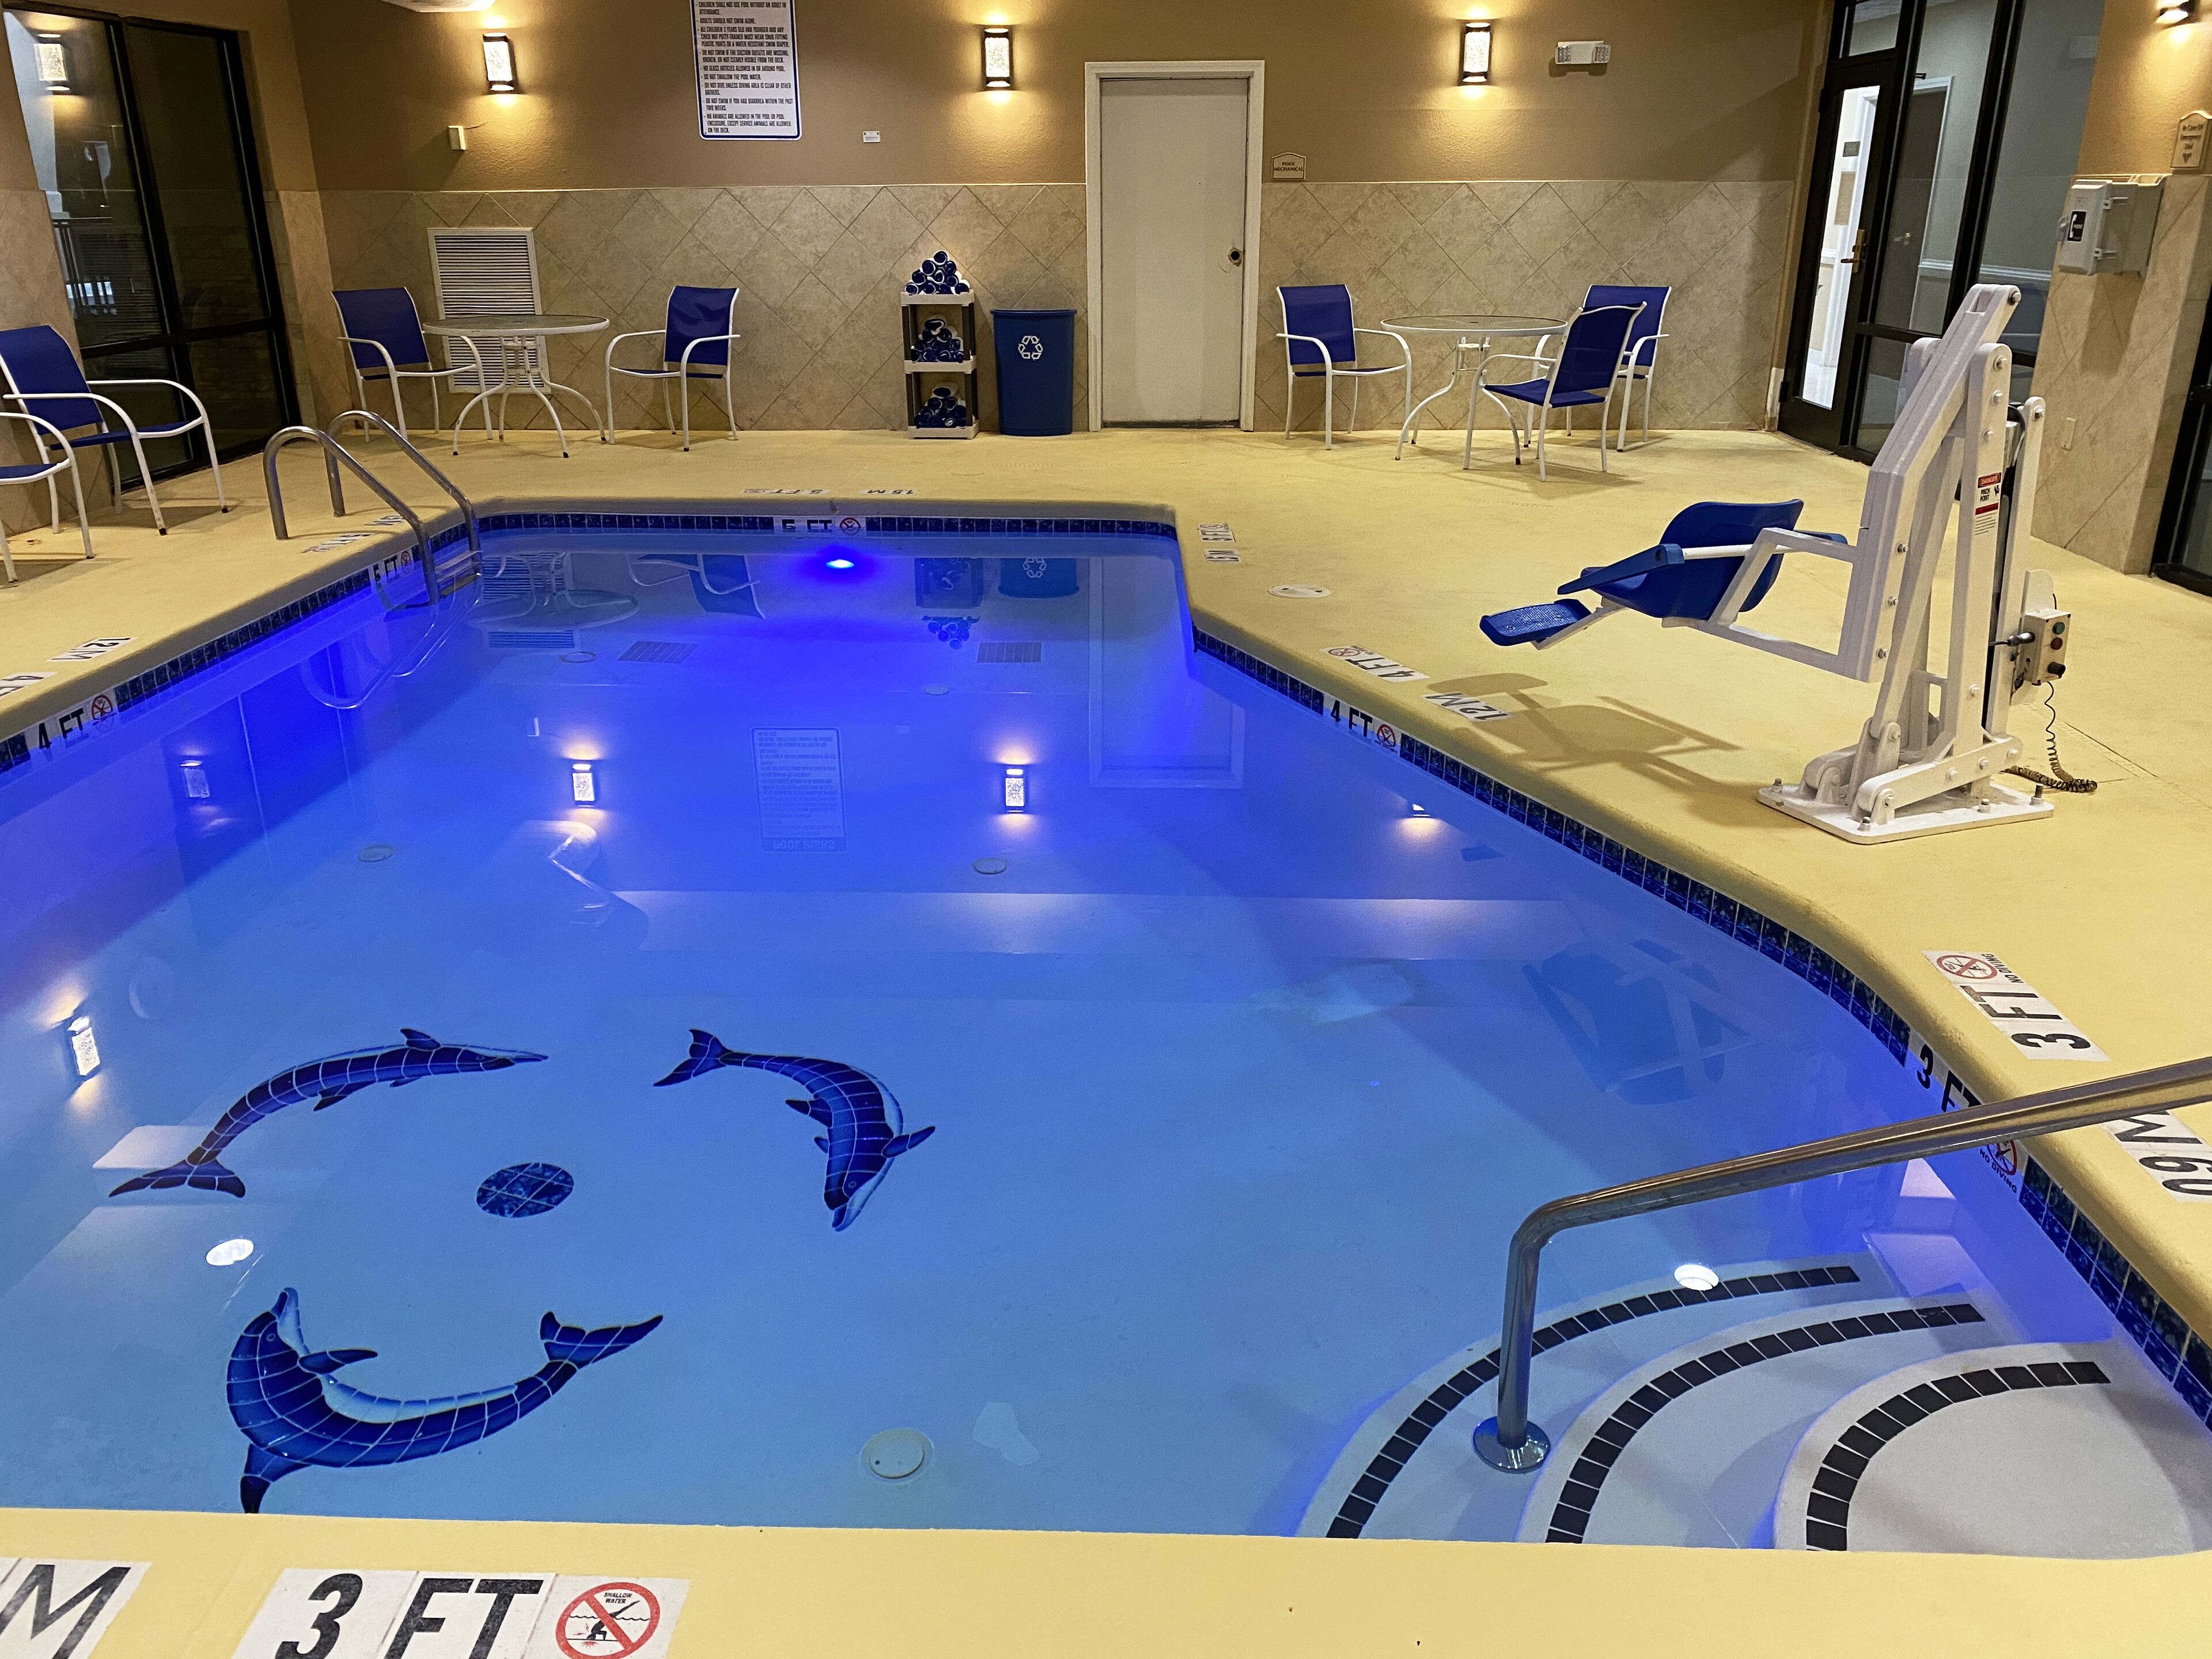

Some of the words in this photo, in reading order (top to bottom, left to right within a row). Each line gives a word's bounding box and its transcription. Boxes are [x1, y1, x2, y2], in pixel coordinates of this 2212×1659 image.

[782, 519, 796, 529] 5
[807, 520, 832, 529] FT
[384, 555, 397, 577] FT
[51, 650, 108, 660] M
[1346, 657, 1401, 670] FT
[1377, 670, 1416, 679] 4
[1425, 692, 1480, 706] M
[38, 722, 52, 749] 4
[59, 707, 84, 739] FT
[1330, 700, 1341, 723] 4
[1349, 707, 1373, 737] FT
[1981, 953, 2012, 974] DIVING
[2005, 975, 2024, 983] NO
[1960, 985, 2063, 1020] FT
[2011, 1033, 2091, 1050] 3
[1916, 1044, 1933, 1089] 3
[1979, 1148, 1990, 1163] NO
[1991, 1161, 2017, 1193] DIVING
[0, 1564, 131, 1659] M
[275, 1573, 363, 1659] 3
[384, 1578, 544, 1659] FT
